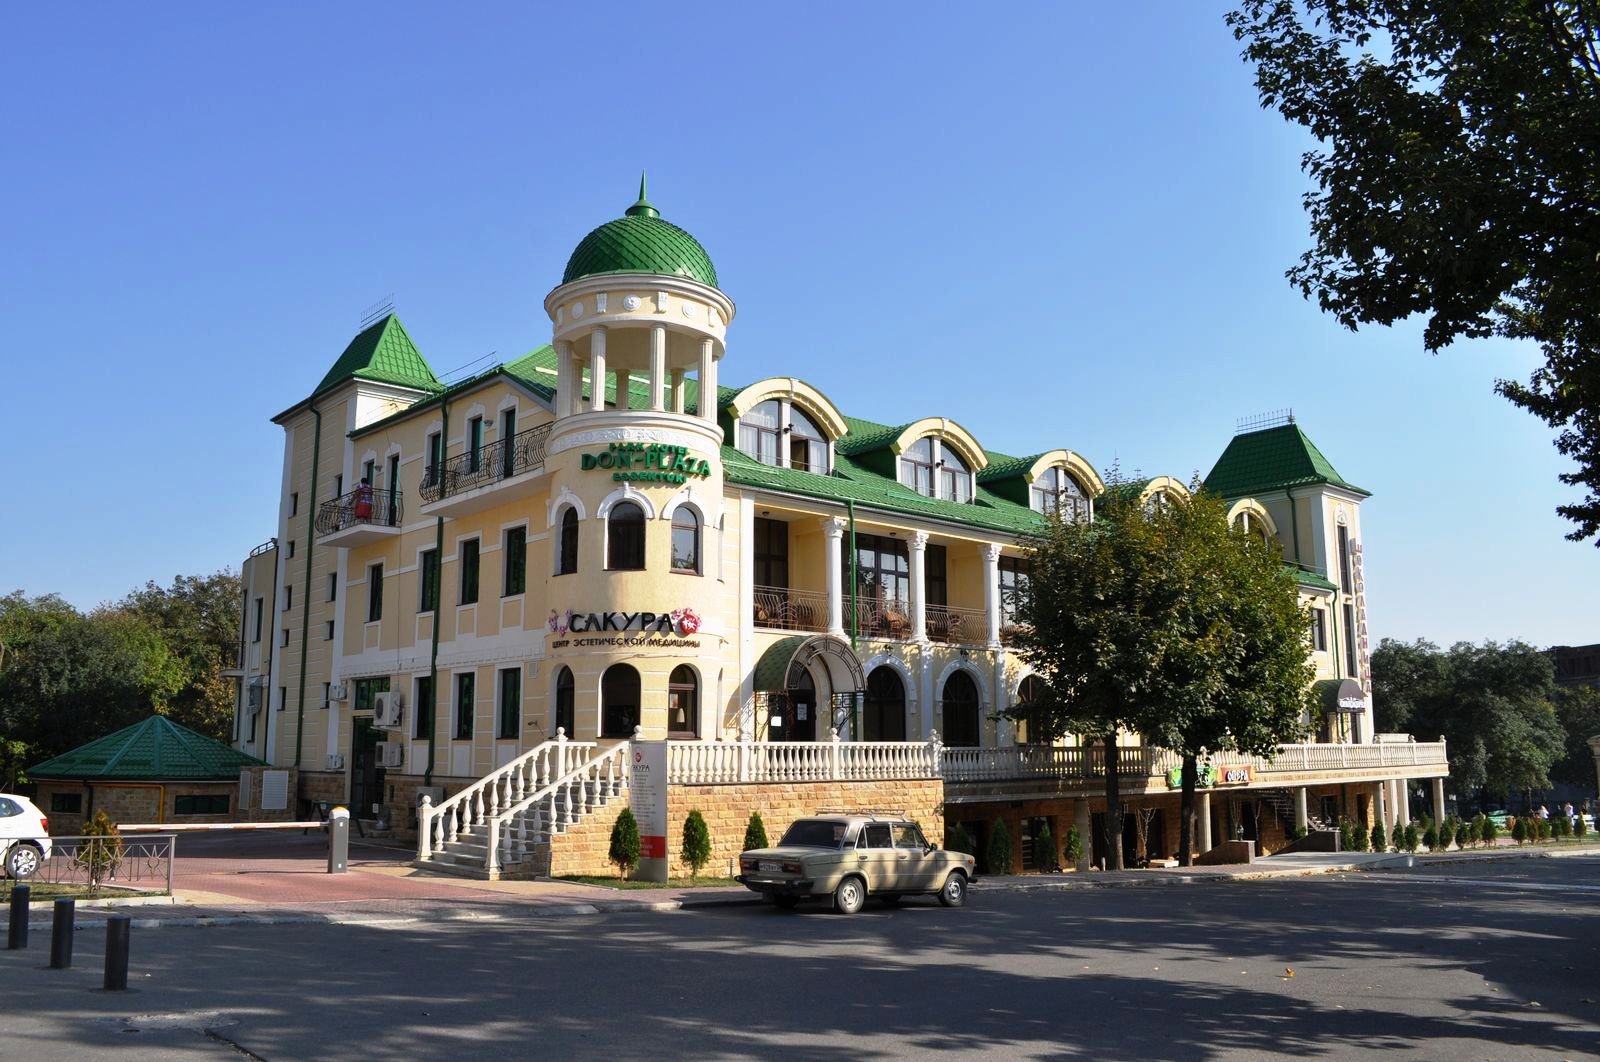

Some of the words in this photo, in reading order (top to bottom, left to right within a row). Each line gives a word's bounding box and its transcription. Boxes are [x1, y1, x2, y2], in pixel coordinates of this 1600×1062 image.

[609, 442, 645, 452] PARK
[650, 443, 690, 455] HOTEL
[581, 451, 711, 477] DON-PLAZA
[569, 612, 674, 633] САКУРА
[552, 640, 570, 649] ЦЕНТР
[573, 636, 646, 647] ЭСТЕТИЧЕСКОЙ
[649, 637, 700, 649] МЕДИЦИНЫ
